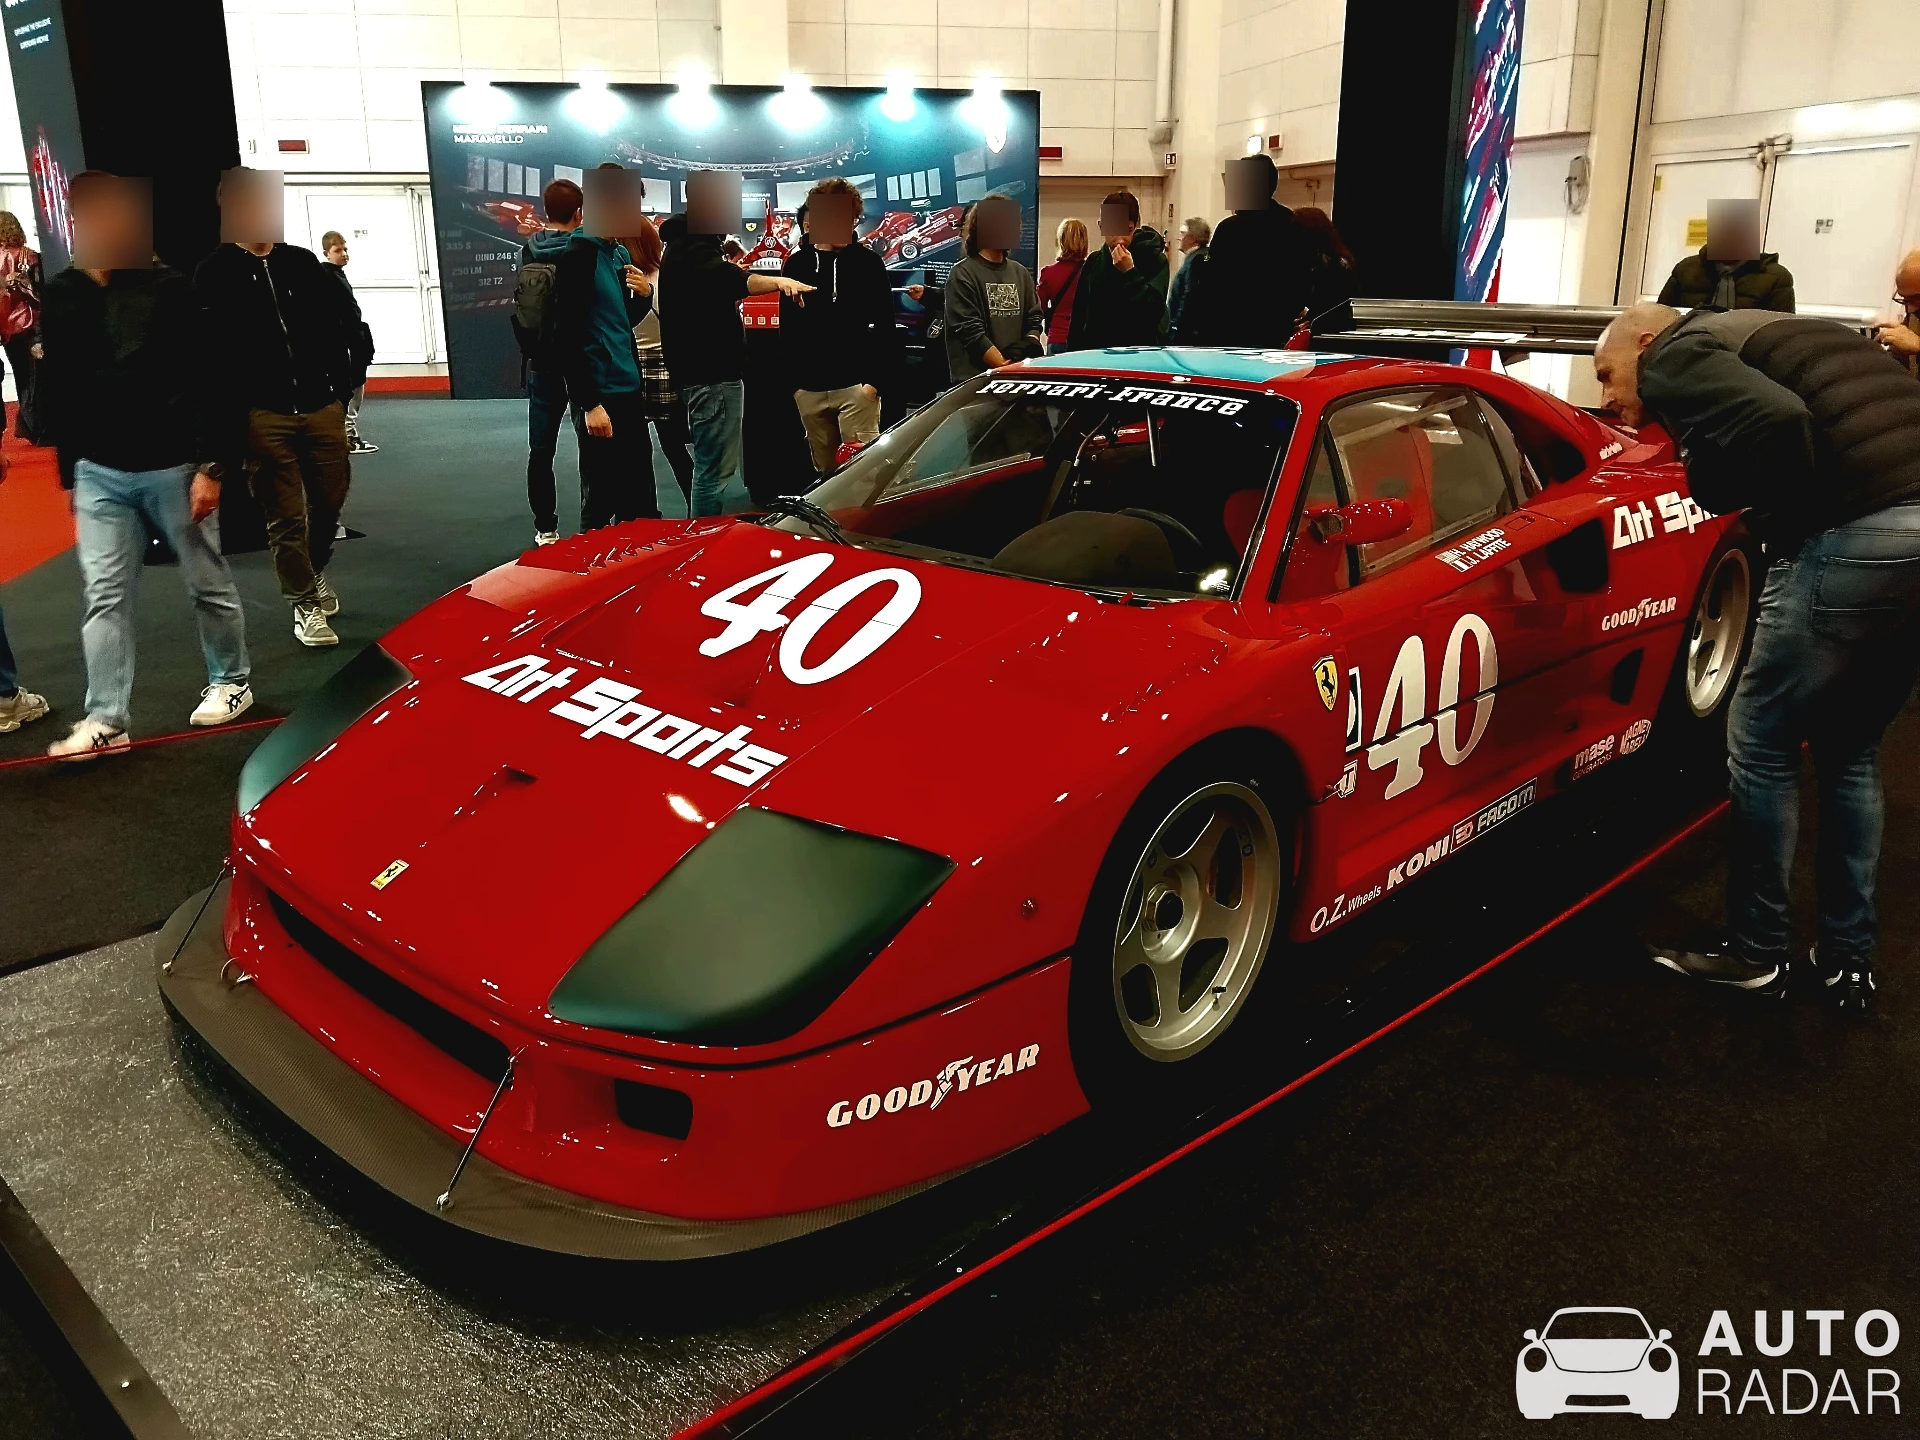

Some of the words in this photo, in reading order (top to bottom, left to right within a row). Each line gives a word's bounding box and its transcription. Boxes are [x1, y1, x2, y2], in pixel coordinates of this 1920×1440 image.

[453, 134, 524, 144] MARANELLO
[475, 253, 495, 262] DINO
[496, 252, 512, 261] 246
[975, 380, 1249, 416] Ferrari-France
[1612, 500, 1654, 550] Art
[698, 552, 922, 685] 40
[1601, 596, 1677, 631] GOODYEAR
[461, 654, 578, 703] Art
[549, 676, 789, 787] Sports
[1366, 613, 1499, 801] 40
[1574, 734, 1615, 770] mase
[1386, 834, 1450, 890] KONI
[1347, 885, 1382, 913] Wheels
[826, 1043, 1040, 1128] GOODYEAR
